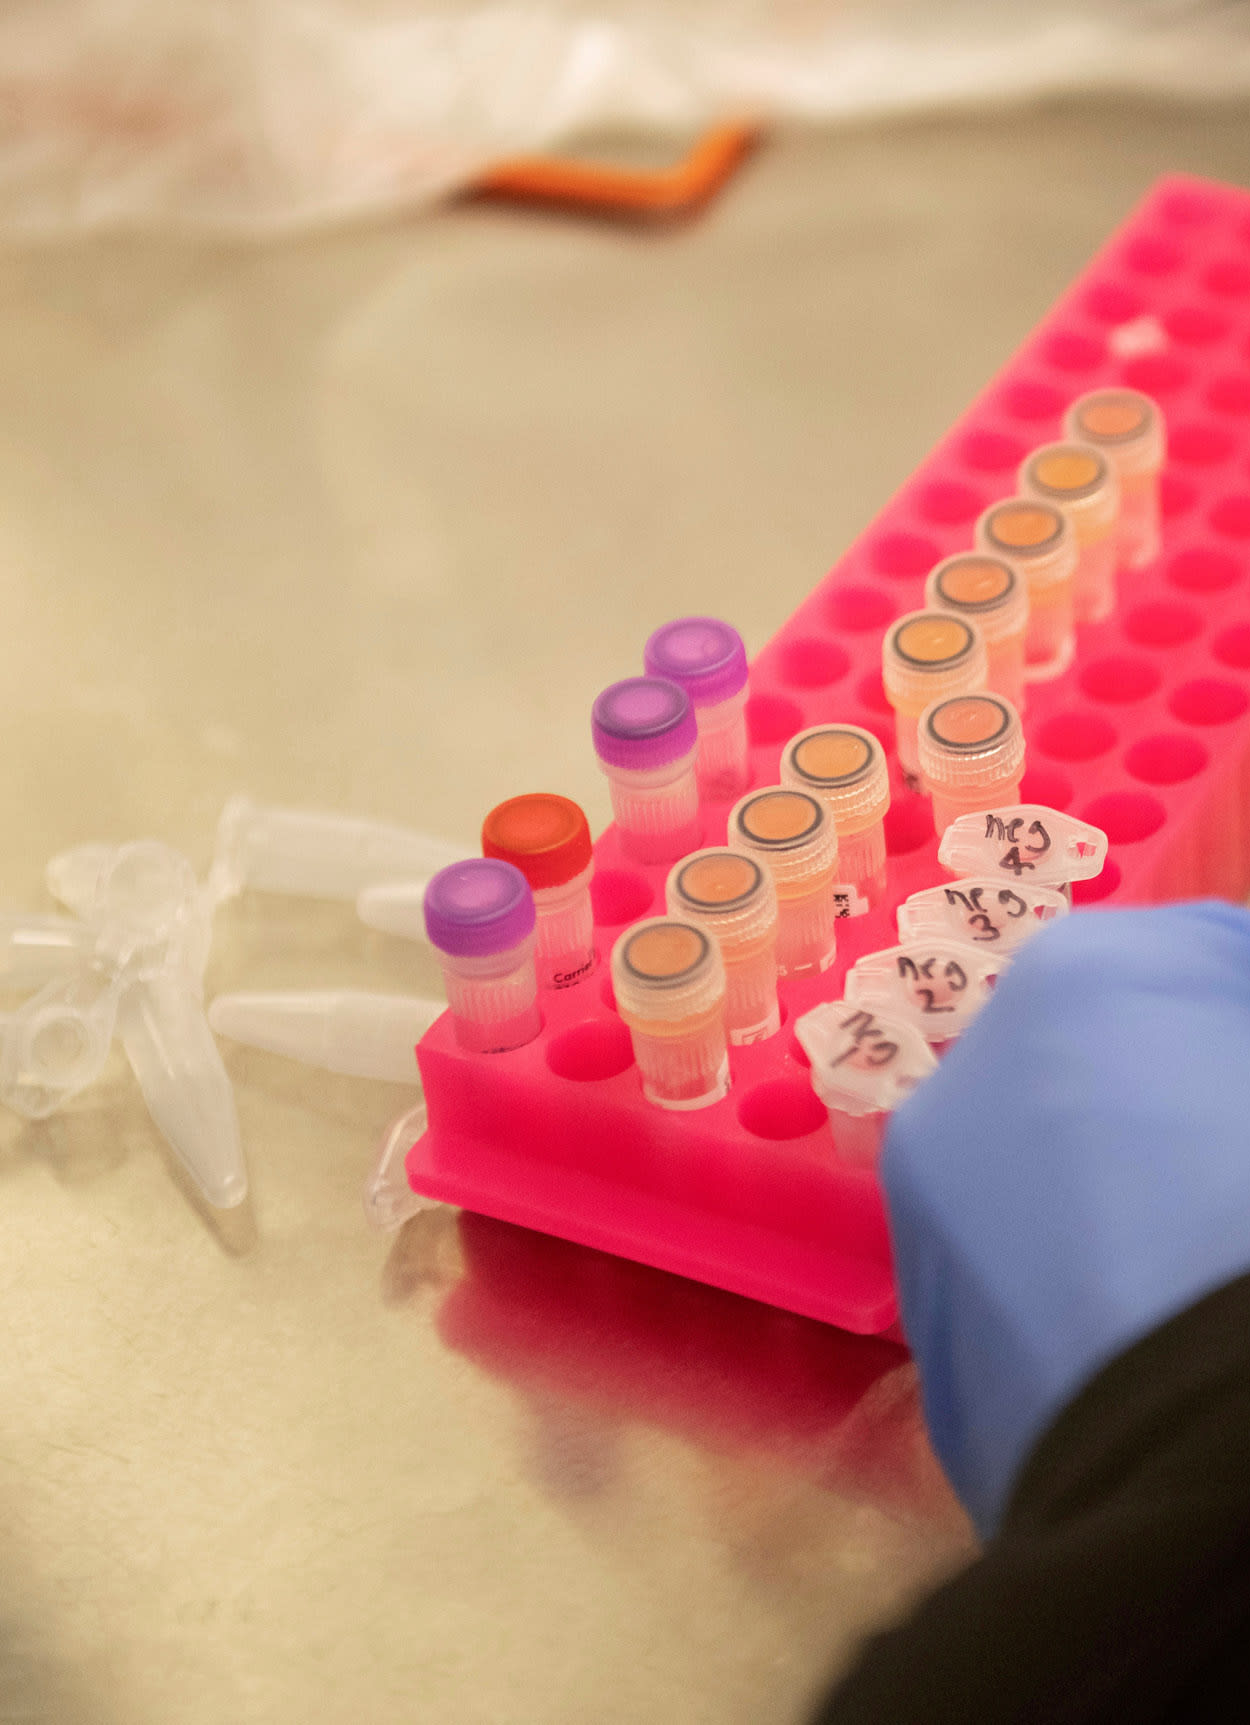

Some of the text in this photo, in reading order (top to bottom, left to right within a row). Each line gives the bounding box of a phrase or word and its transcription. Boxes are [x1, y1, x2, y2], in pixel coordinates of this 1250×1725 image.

[985, 814, 1051, 852] neg
[1000, 847, 1035, 875] 4
[944, 888, 1027, 917] neg
[969, 914, 1000, 941] 3
[916, 989, 955, 1014] 2
